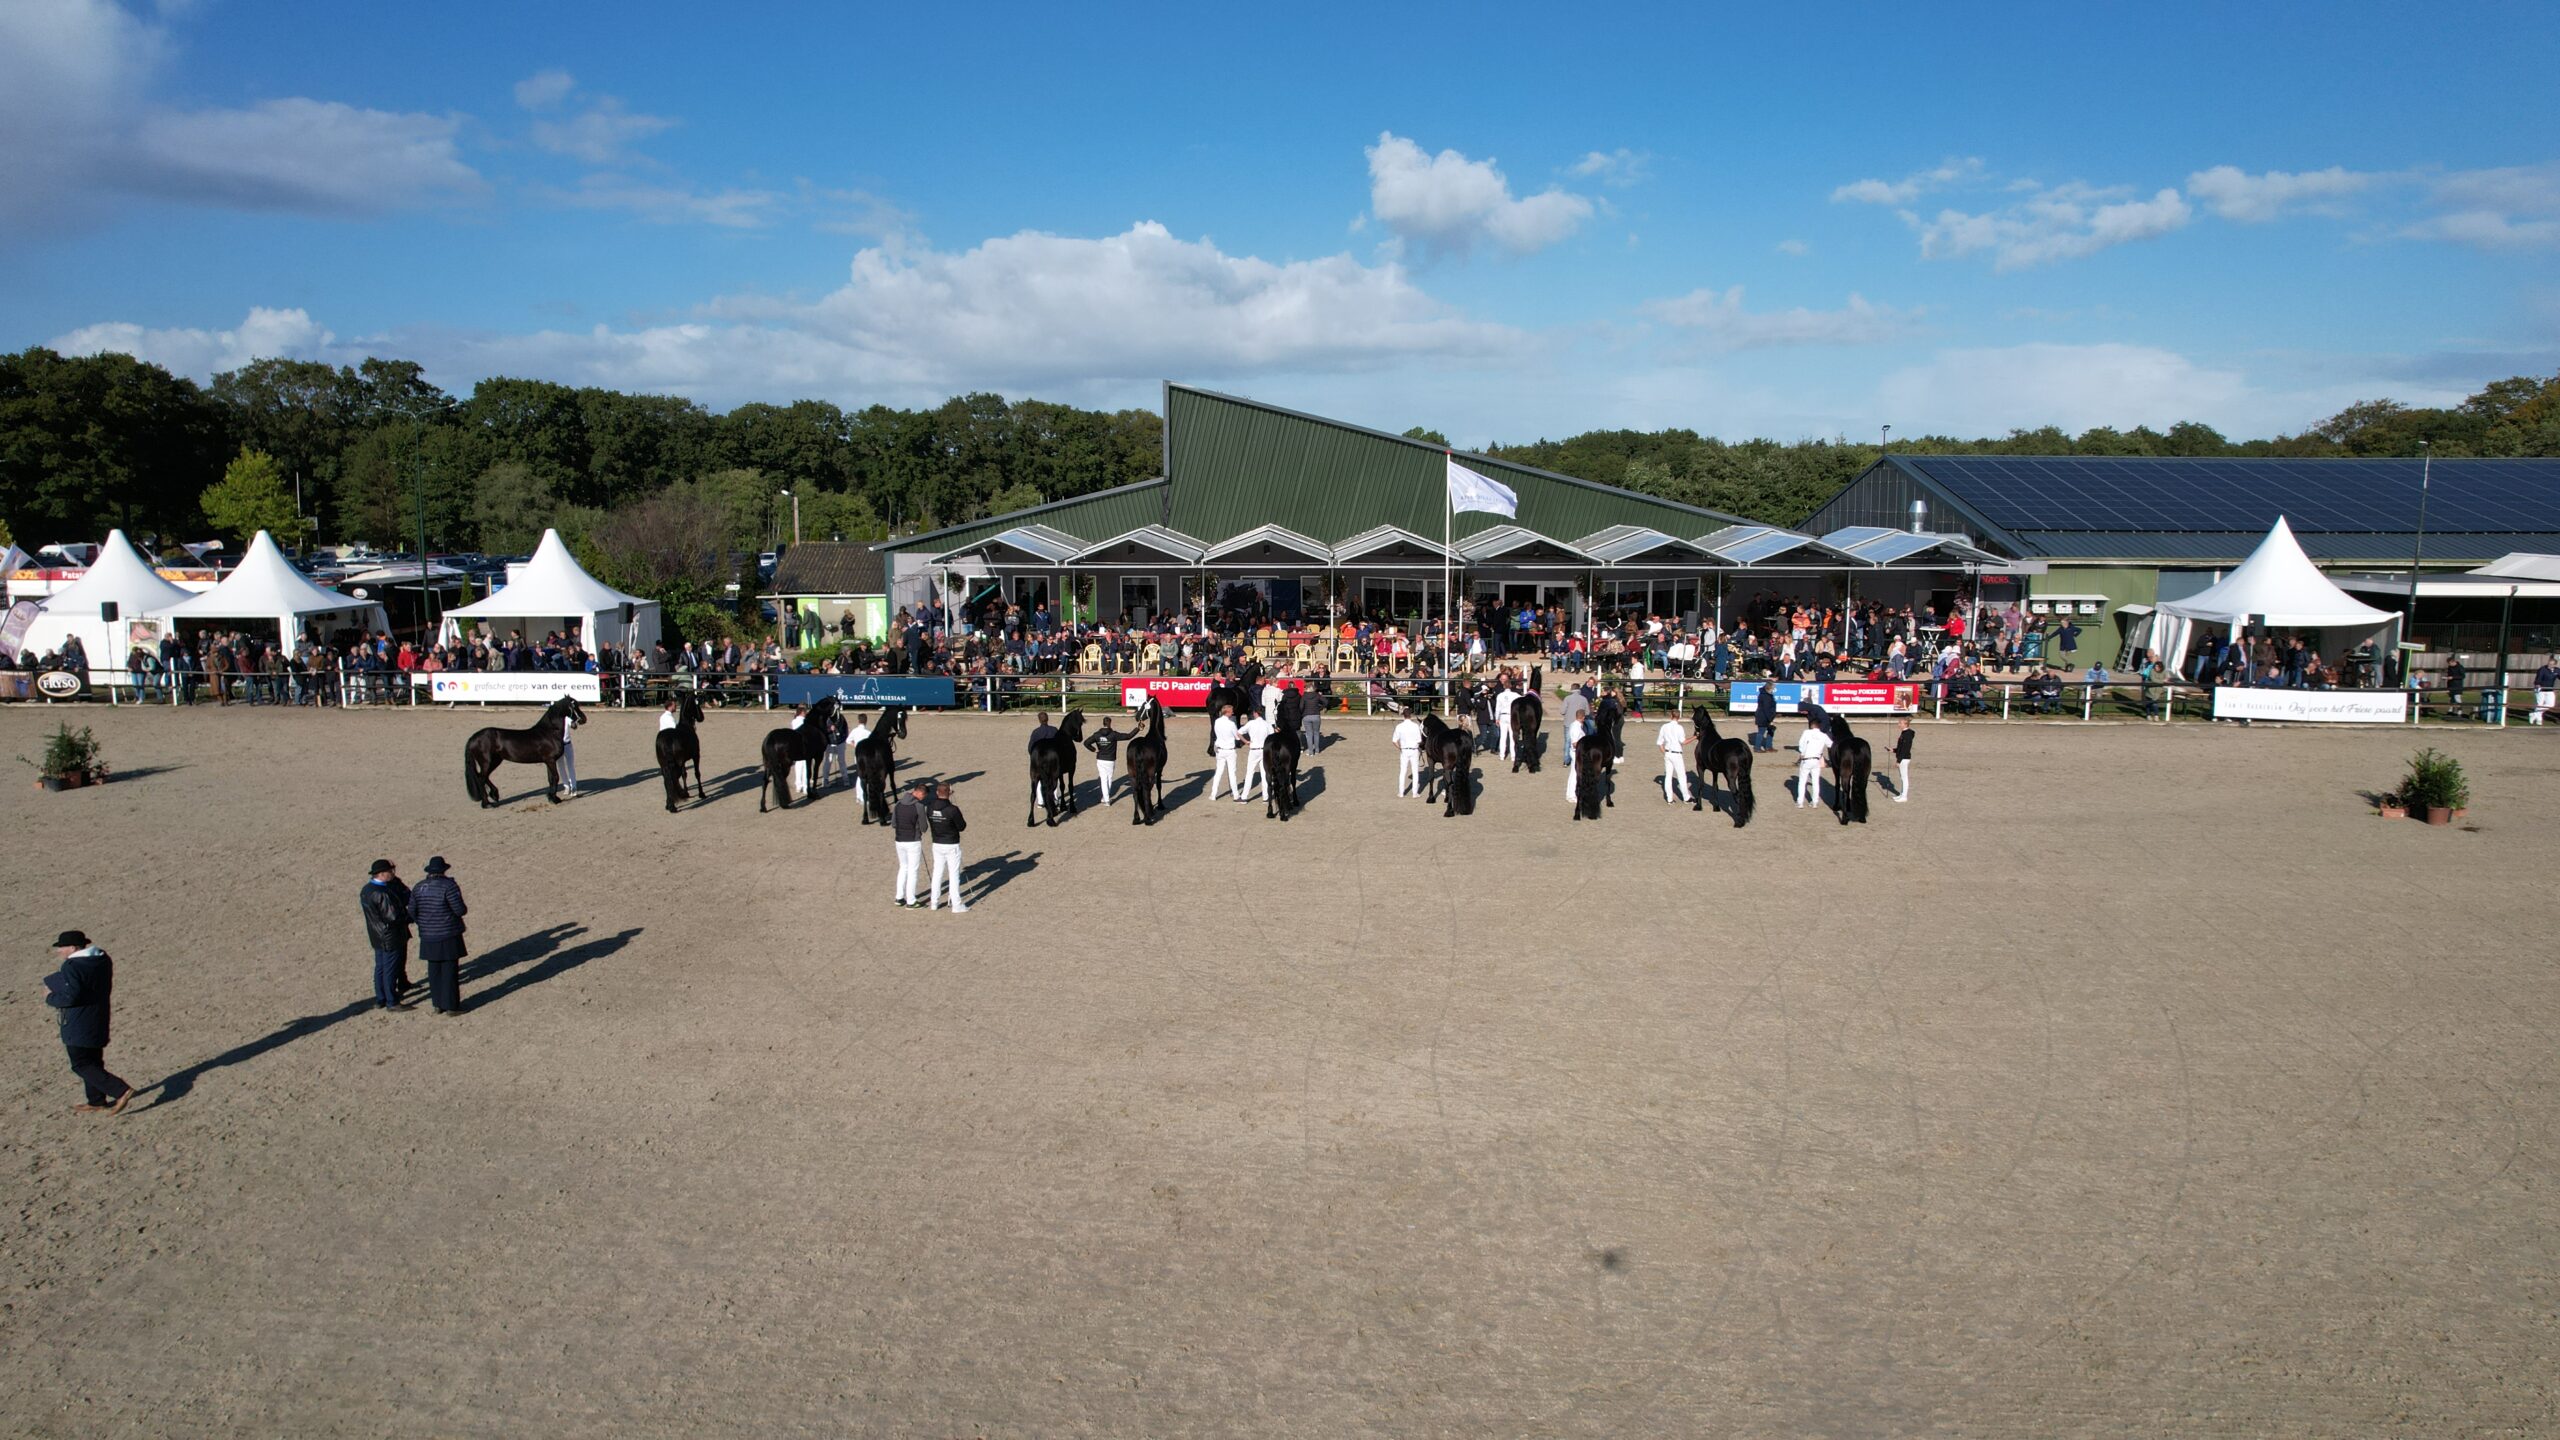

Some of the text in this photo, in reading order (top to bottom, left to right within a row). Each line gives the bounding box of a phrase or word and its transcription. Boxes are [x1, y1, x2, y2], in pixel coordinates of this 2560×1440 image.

[1981, 575, 2009, 584] NACKS
[43, 676, 76, 689] FRYSO
[474, 682, 506, 692] grafische
[508, 683, 529, 692] groep
[551, 682, 567, 690] der
[570, 683, 597, 691] eems
[1149, 681, 1170, 691] EFO
